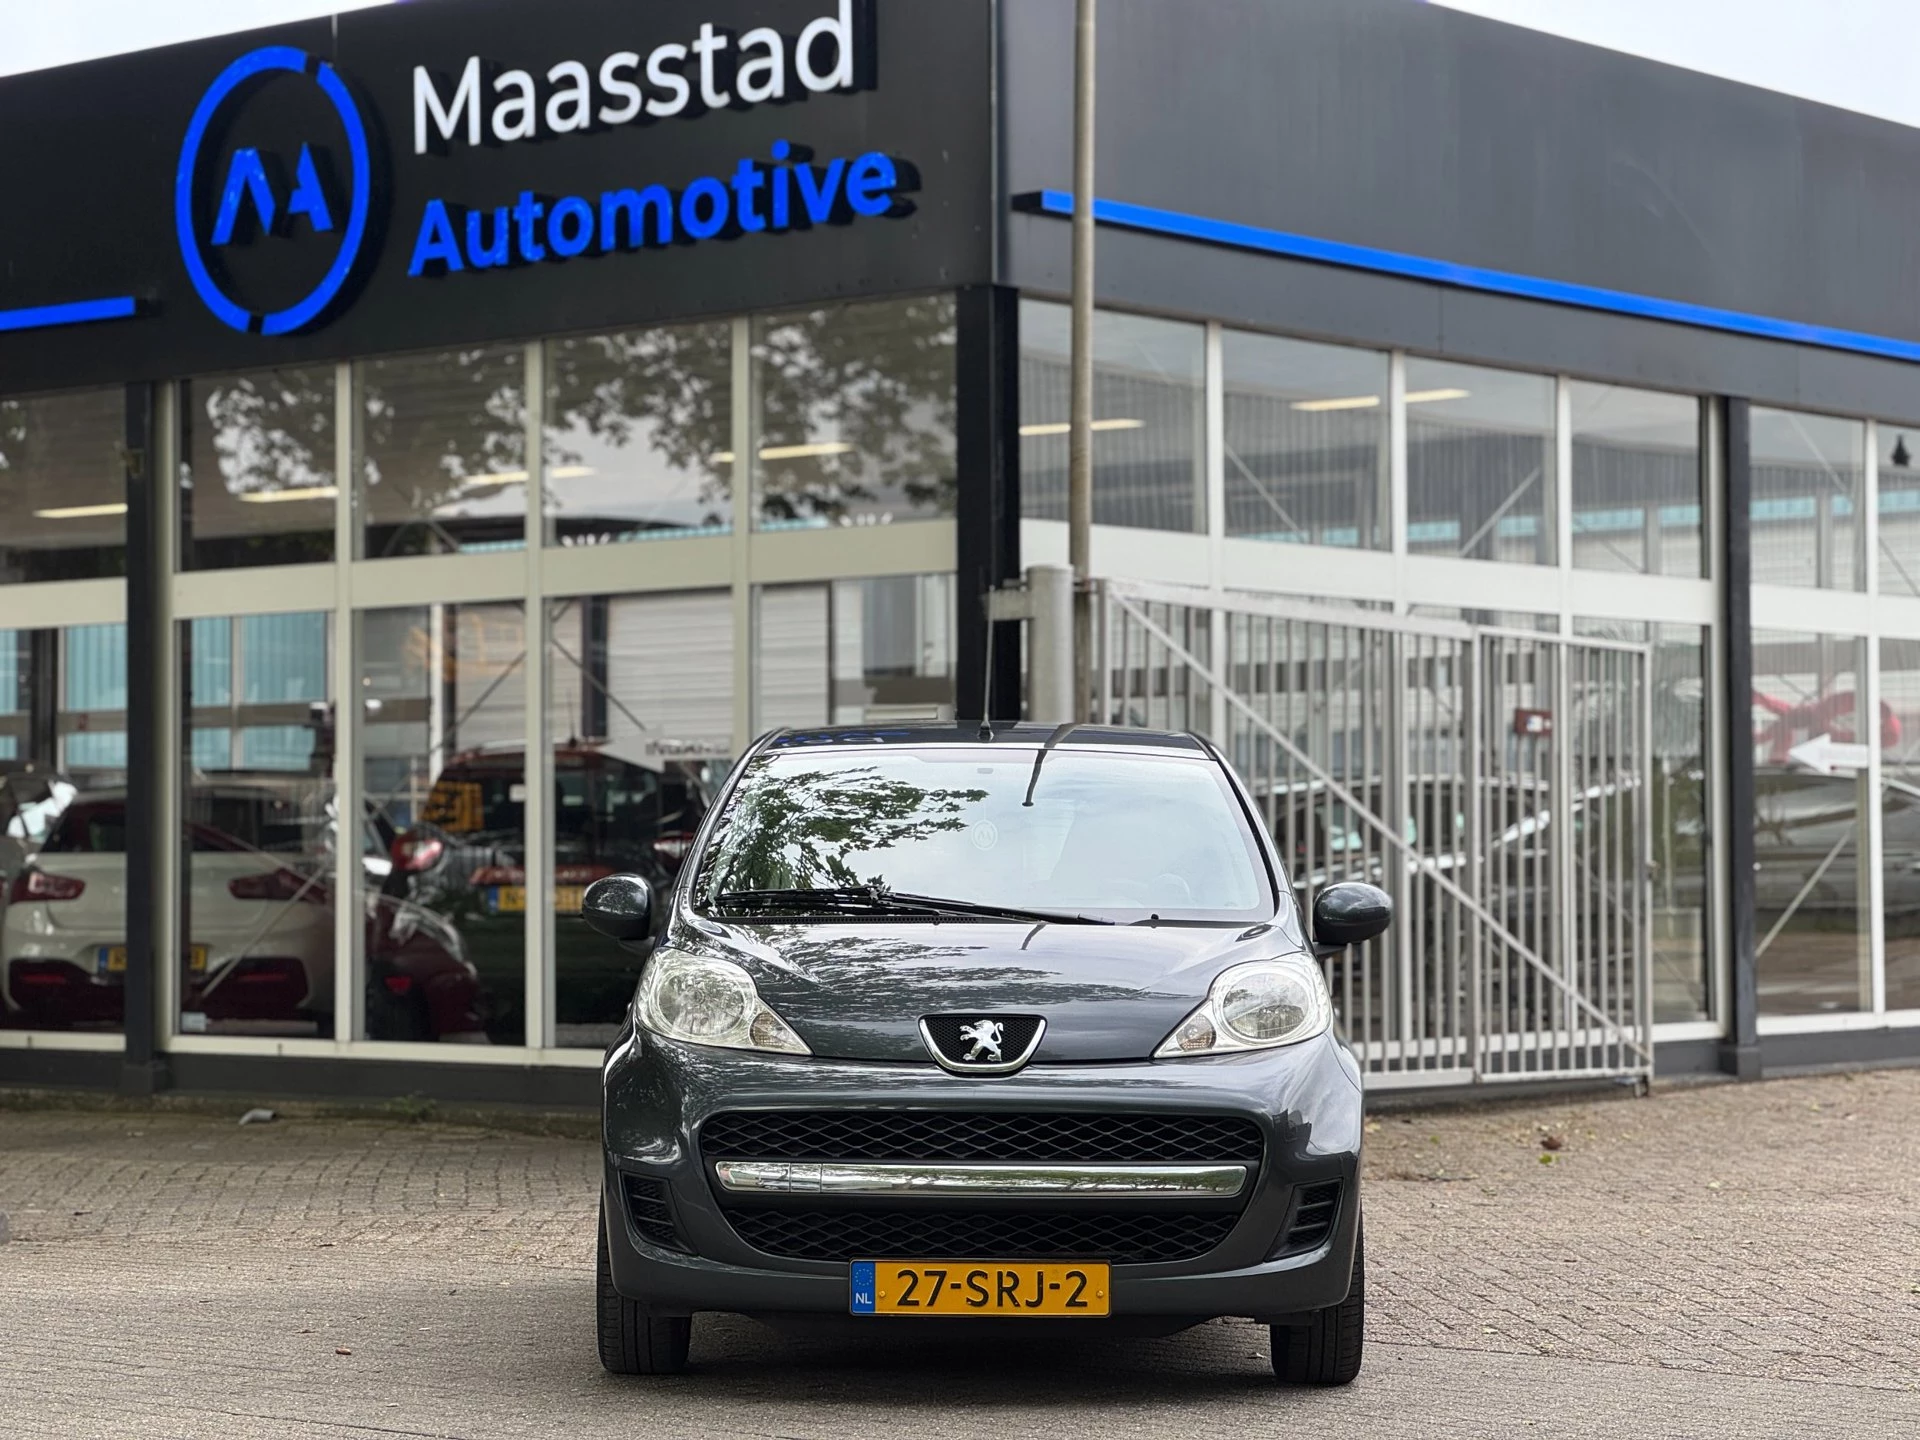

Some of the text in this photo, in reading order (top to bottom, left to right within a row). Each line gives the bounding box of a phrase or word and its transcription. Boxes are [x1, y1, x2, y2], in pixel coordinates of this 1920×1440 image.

[412, 0, 854, 154] Maasstad
[408, 140, 897, 276] Automotive
[855, 1269, 1088, 1308] NL 27-SRJ-2
